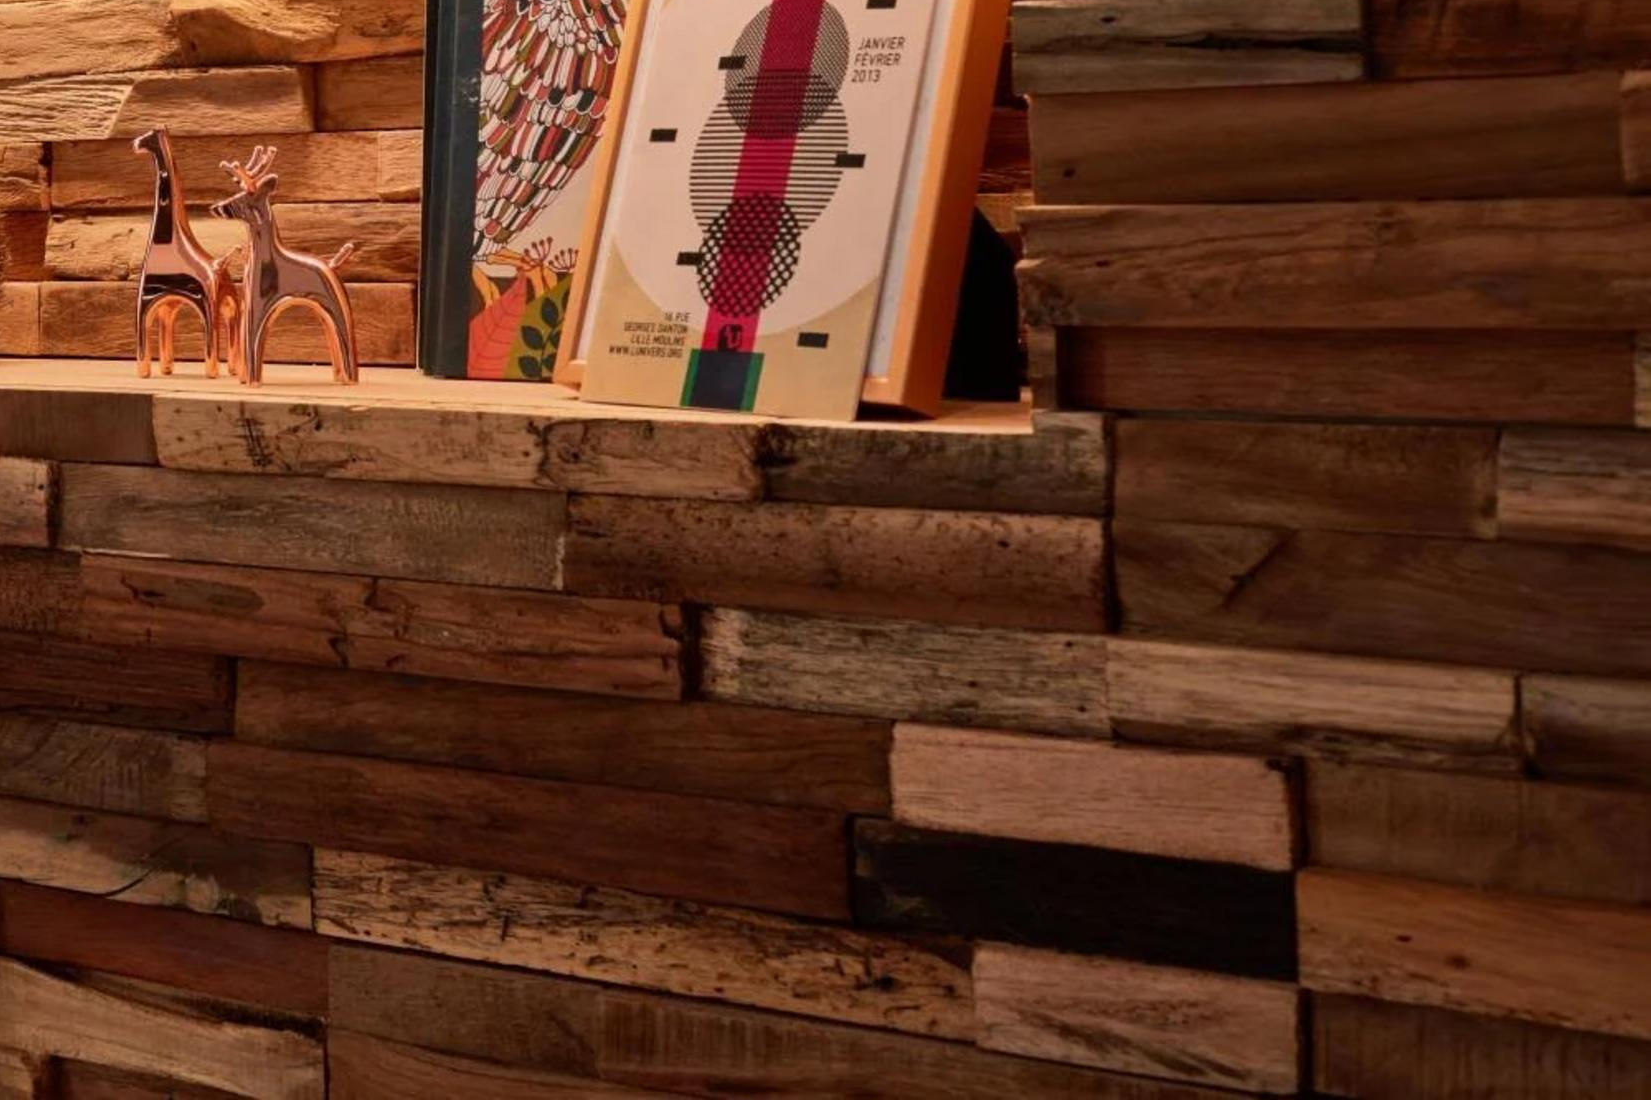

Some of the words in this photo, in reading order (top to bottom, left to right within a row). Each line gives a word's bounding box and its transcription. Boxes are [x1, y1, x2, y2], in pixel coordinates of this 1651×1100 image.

[858, 36, 906, 50] JANVIER
[853, 51, 902, 67] FÉVRIER
[851, 69, 882, 83] 2013
[623, 321, 656, 332] GEORGES
[657, 322, 688, 334] DANTON
